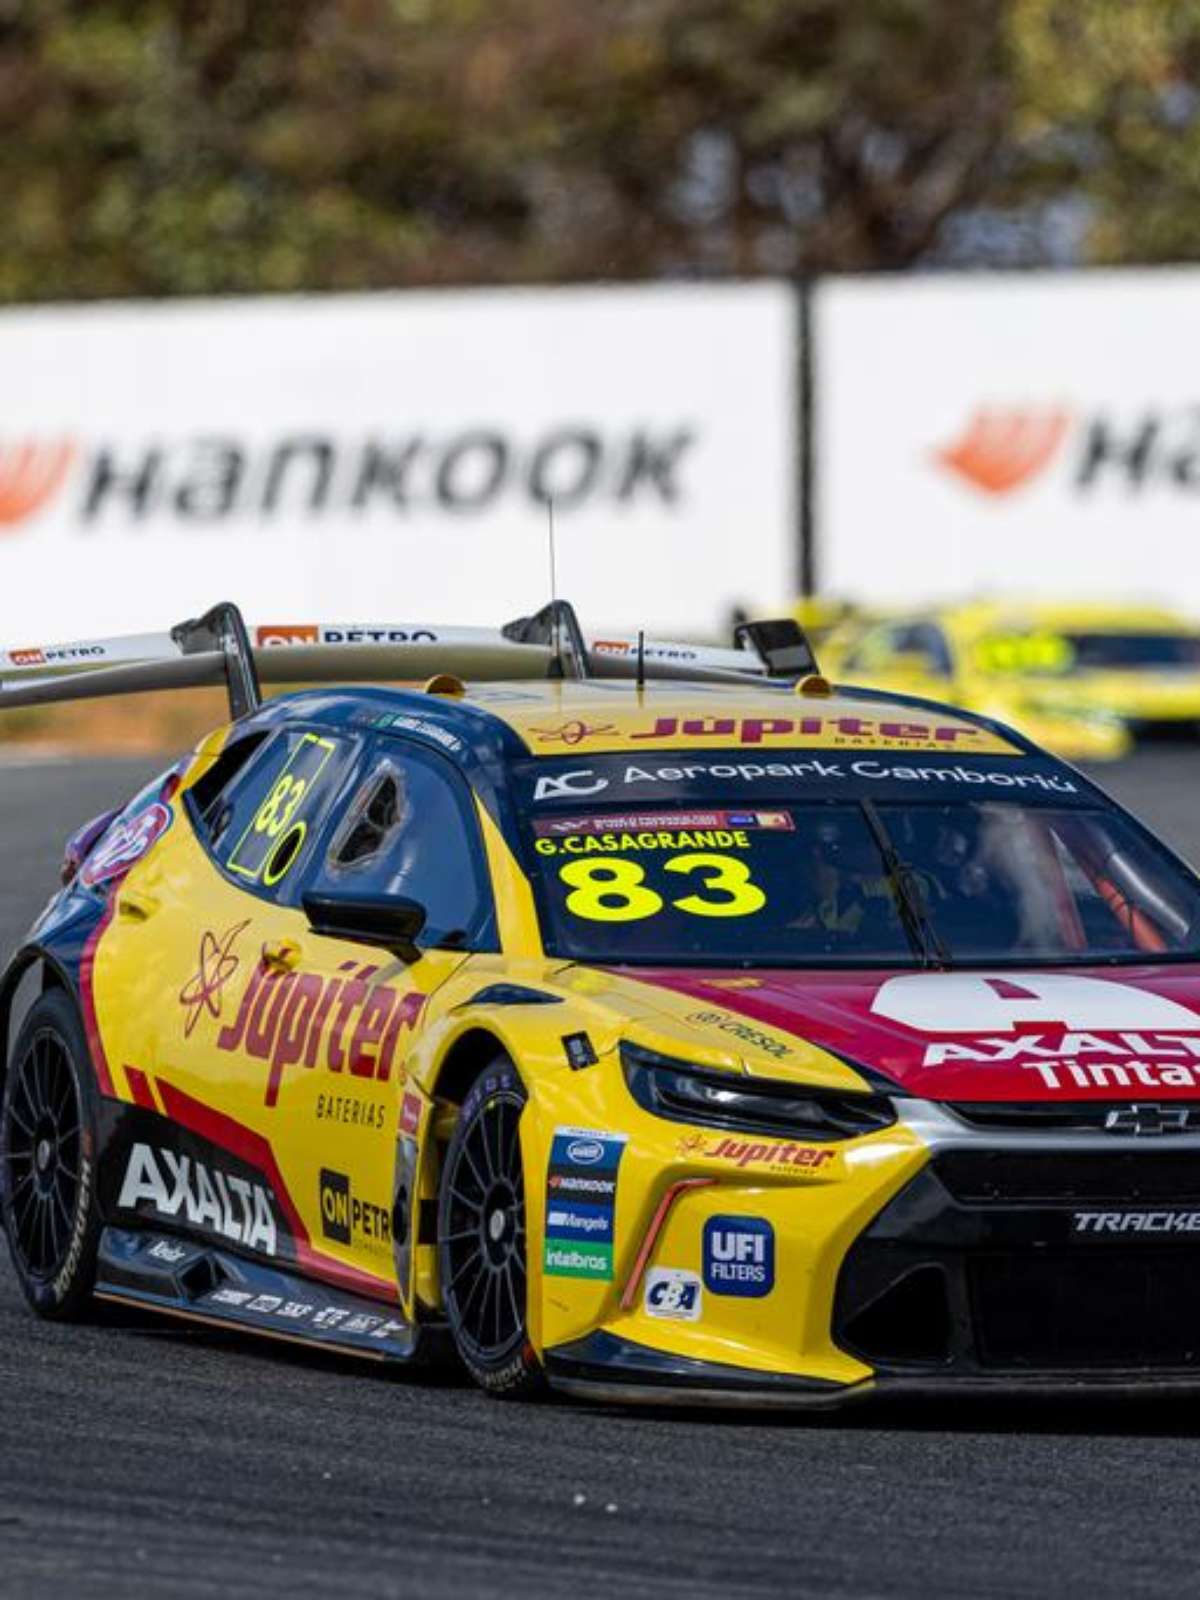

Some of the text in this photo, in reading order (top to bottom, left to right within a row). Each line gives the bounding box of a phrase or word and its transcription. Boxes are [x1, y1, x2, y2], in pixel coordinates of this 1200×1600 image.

[533, 760, 1077, 801] AC Aeropark Camboriú
[254, 774, 305, 837] 83
[534, 830, 751, 855] G.CASAGRANDE
[559, 852, 767, 922] 83
[1022, 1060, 1200, 1088] Tinta
[316, 1095, 386, 1129] BATERIAS
[117, 1142, 276, 1256] AXALTA
[711, 1231, 765, 1263] UFI
[710, 1262, 766, 1282] FILTERS
[649, 1281, 698, 1310] CBA
